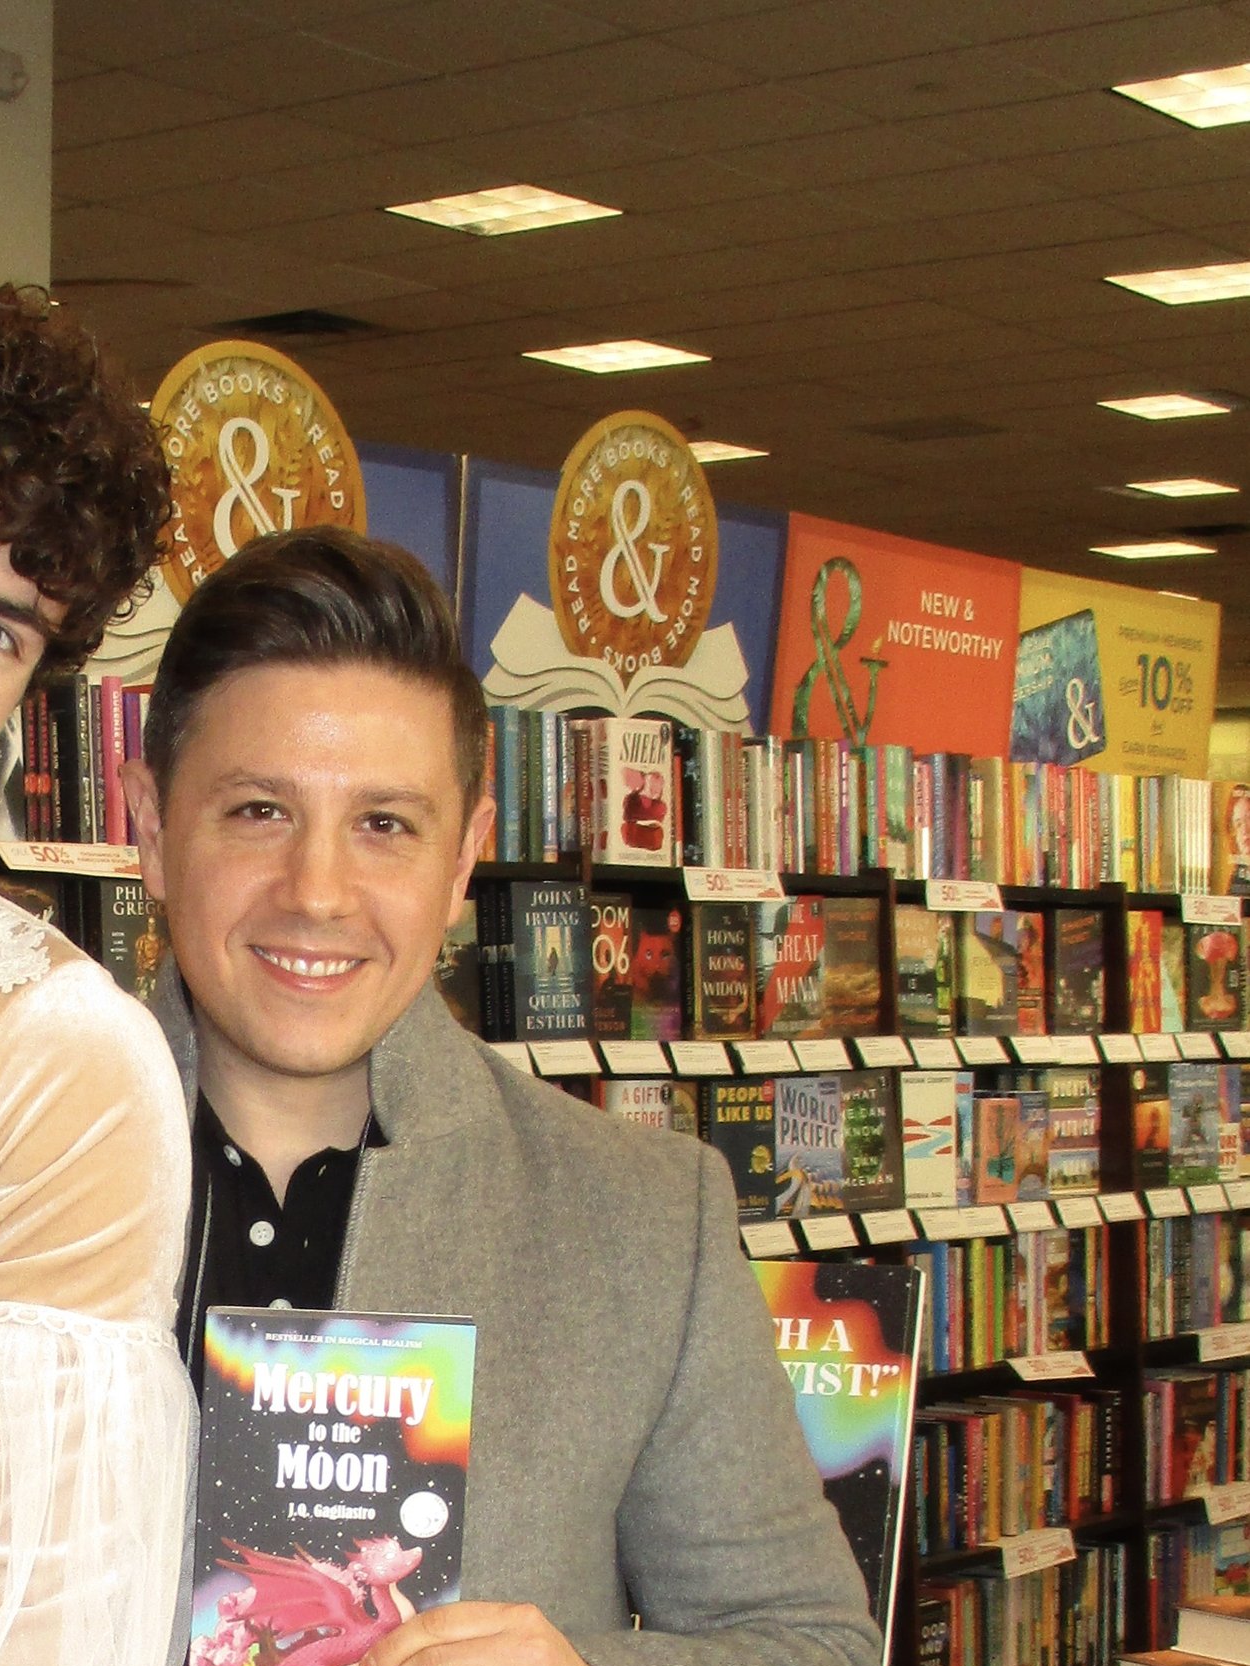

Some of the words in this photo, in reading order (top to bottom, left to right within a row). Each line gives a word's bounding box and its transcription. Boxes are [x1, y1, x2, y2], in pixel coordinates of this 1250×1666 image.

[203, 374, 284, 404] BOOKS
[308, 424, 344, 510] READ
[603, 441, 667, 469] BOOKS
[568, 466, 602, 541] MORE
[681, 487, 703, 562] READ
[565, 555, 591, 635] READ
[921, 590, 958, 618] NEW
[963, 599, 974, 622] &
[666, 576, 700, 650] MORE
[888, 620, 1004, 661] NOTEWORTHY
[603, 646, 662, 672] BOOKS
[531, 890, 572, 906] JOHN
[525, 911, 580, 926] IRVING
[707, 929, 745, 945] HONG
[772, 934, 820, 963] GREAT
[708, 955, 746, 971] KONG
[528, 993, 581, 1010] QUEEN
[702, 981, 748, 997] WIDOW
[775, 976, 819, 1003] MANN
[526, 1014, 586, 1031] ESTHER
[621, 1088, 630, 1105] A
[633, 1087, 662, 1105] GIFT
[717, 1086, 764, 1103] PEOPL
[780, 1083, 839, 1126] WORLD
[717, 1106, 750, 1123] LIKE
[755, 1105, 774, 1120] US
[779, 1115, 840, 1149] PACIFIC
[265, 1333, 324, 1344] BESTSELLER
[325, 1335, 337, 1344] IN
[338, 1336, 380, 1347] MAGICAL
[382, 1339, 423, 1349] REALISM
[820, 1319, 854, 1352] A
[252, 1362, 434, 1426] Mercury
[308, 1420, 327, 1443] to
[331, 1421, 362, 1444] the
[275, 1444, 388, 1494] Moon
[288, 1503, 310, 1520] J.Q.
[313, 1503, 377, 1522] Gagliastro
